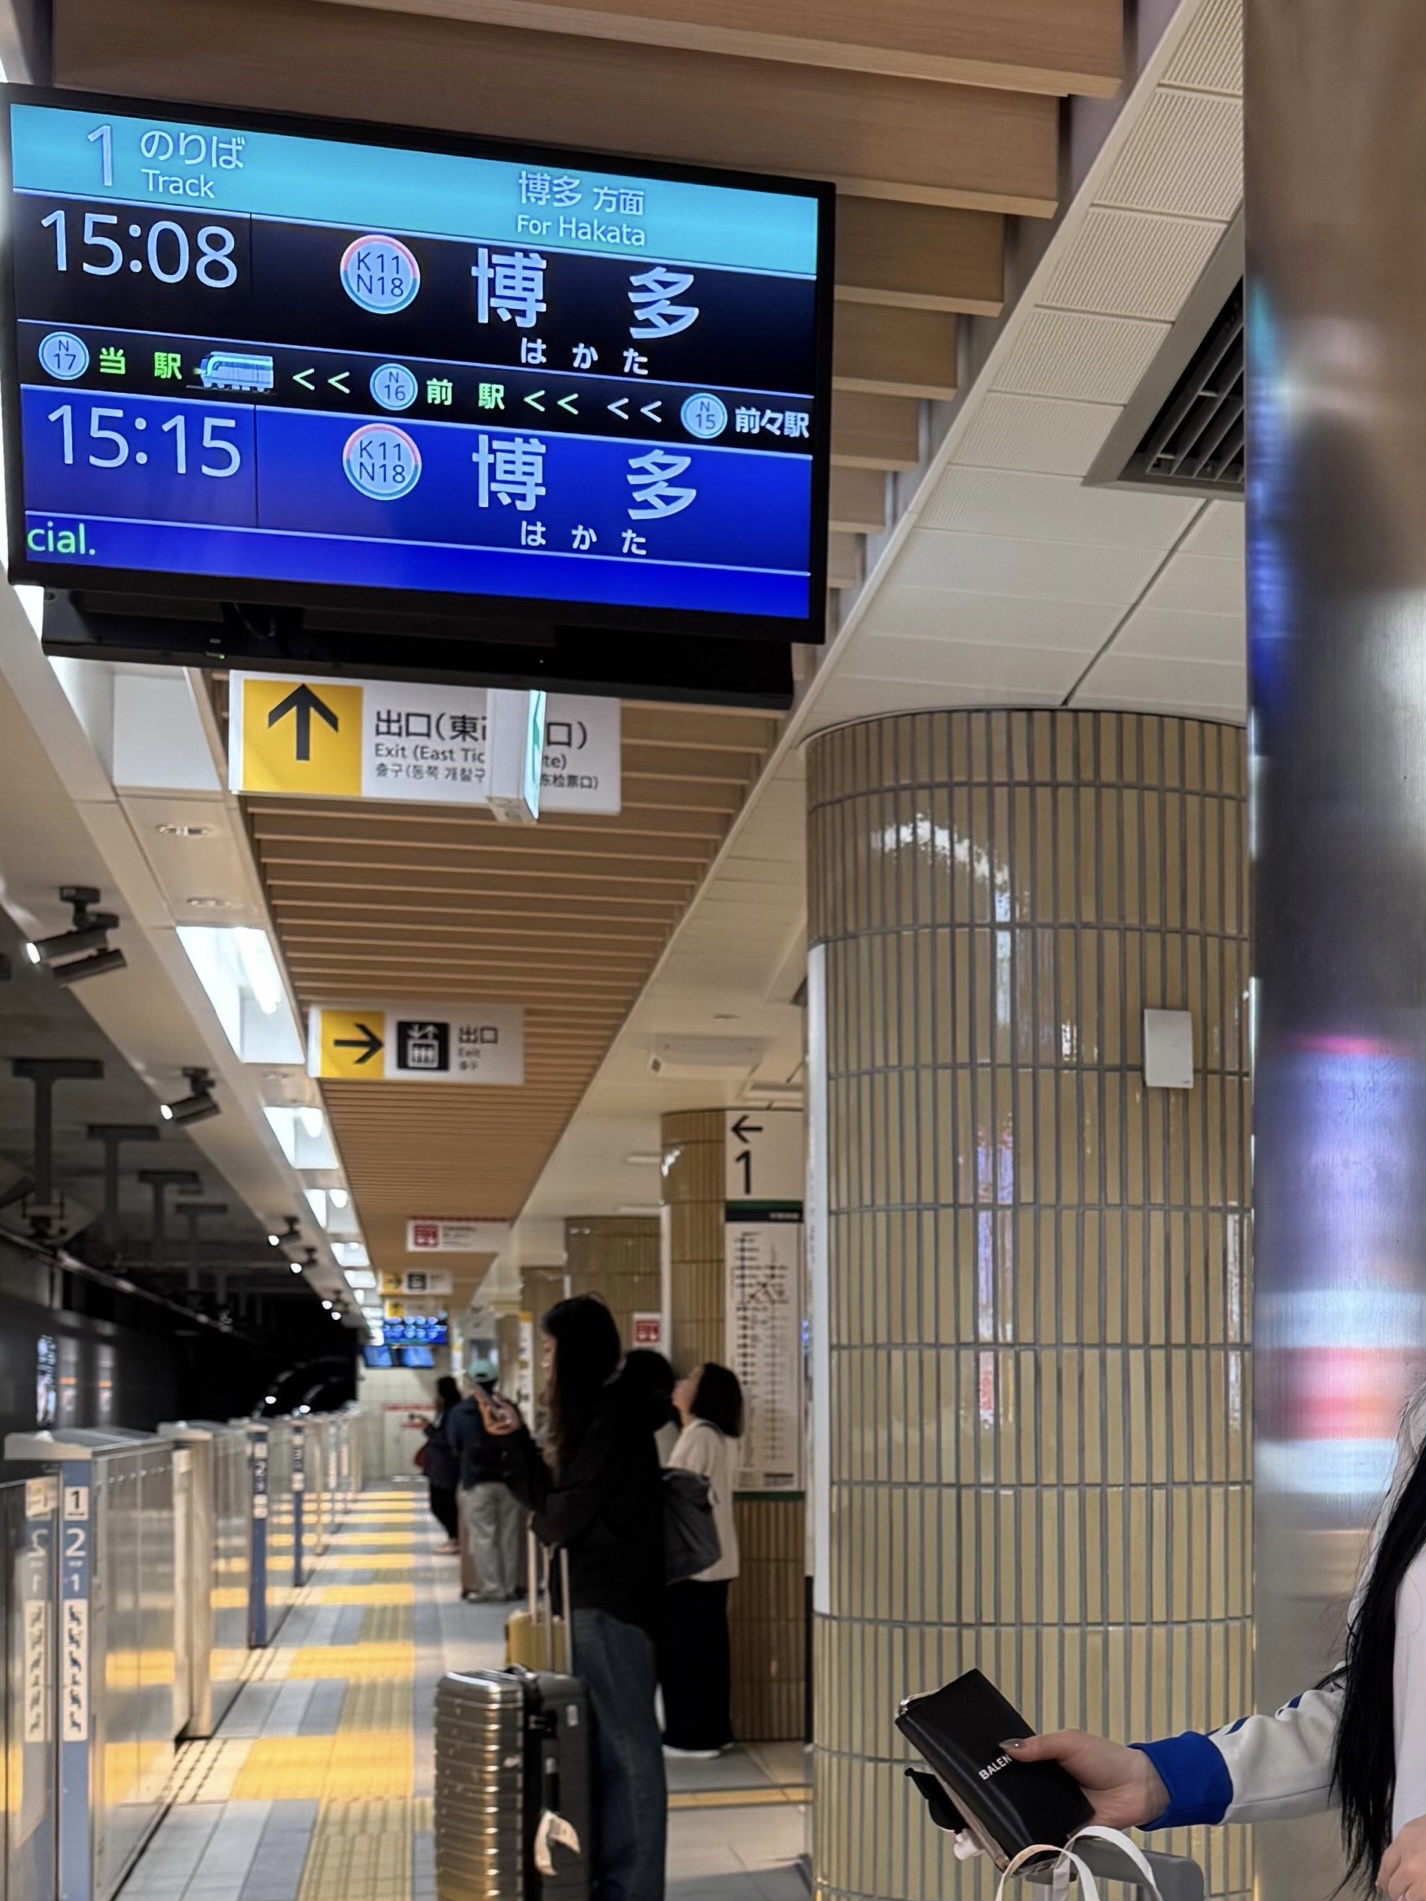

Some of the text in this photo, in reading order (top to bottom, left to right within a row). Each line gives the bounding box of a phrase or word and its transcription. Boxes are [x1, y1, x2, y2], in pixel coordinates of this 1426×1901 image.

[87, 124, 246, 187] 1 のりば
[140, 168, 215, 199] Track
[516, 214, 646, 247] For Hakata
[40, 209, 239, 289] 15:08
[356, 250, 402, 275] K11
[356, 274, 405, 298] N18
[58, 339, 69, 353] N
[53, 352, 77, 371] 17
[388, 371, 399, 384] N
[383, 383, 406, 402] 16
[700, 400, 711, 413] N
[694, 412, 717, 430] 15
[734, 406, 810, 439] 前々駅
[47, 404, 242, 478] 15:15
[359, 439, 403, 461] K11
[358, 461, 406, 484] N18
[26, 520, 97, 556] cial.
[374, 743, 408, 760] Exit
[413, 744, 456, 764] (East
[461, 746, 486, 764] Tic
[735, 1149, 752, 1196] 1
[71, 1489, 81, 1510] 1
[65, 1527, 87, 1558] 2
[69, 1573, 81, 1592] 1
[978, 1753, 1013, 1781] BALEN
